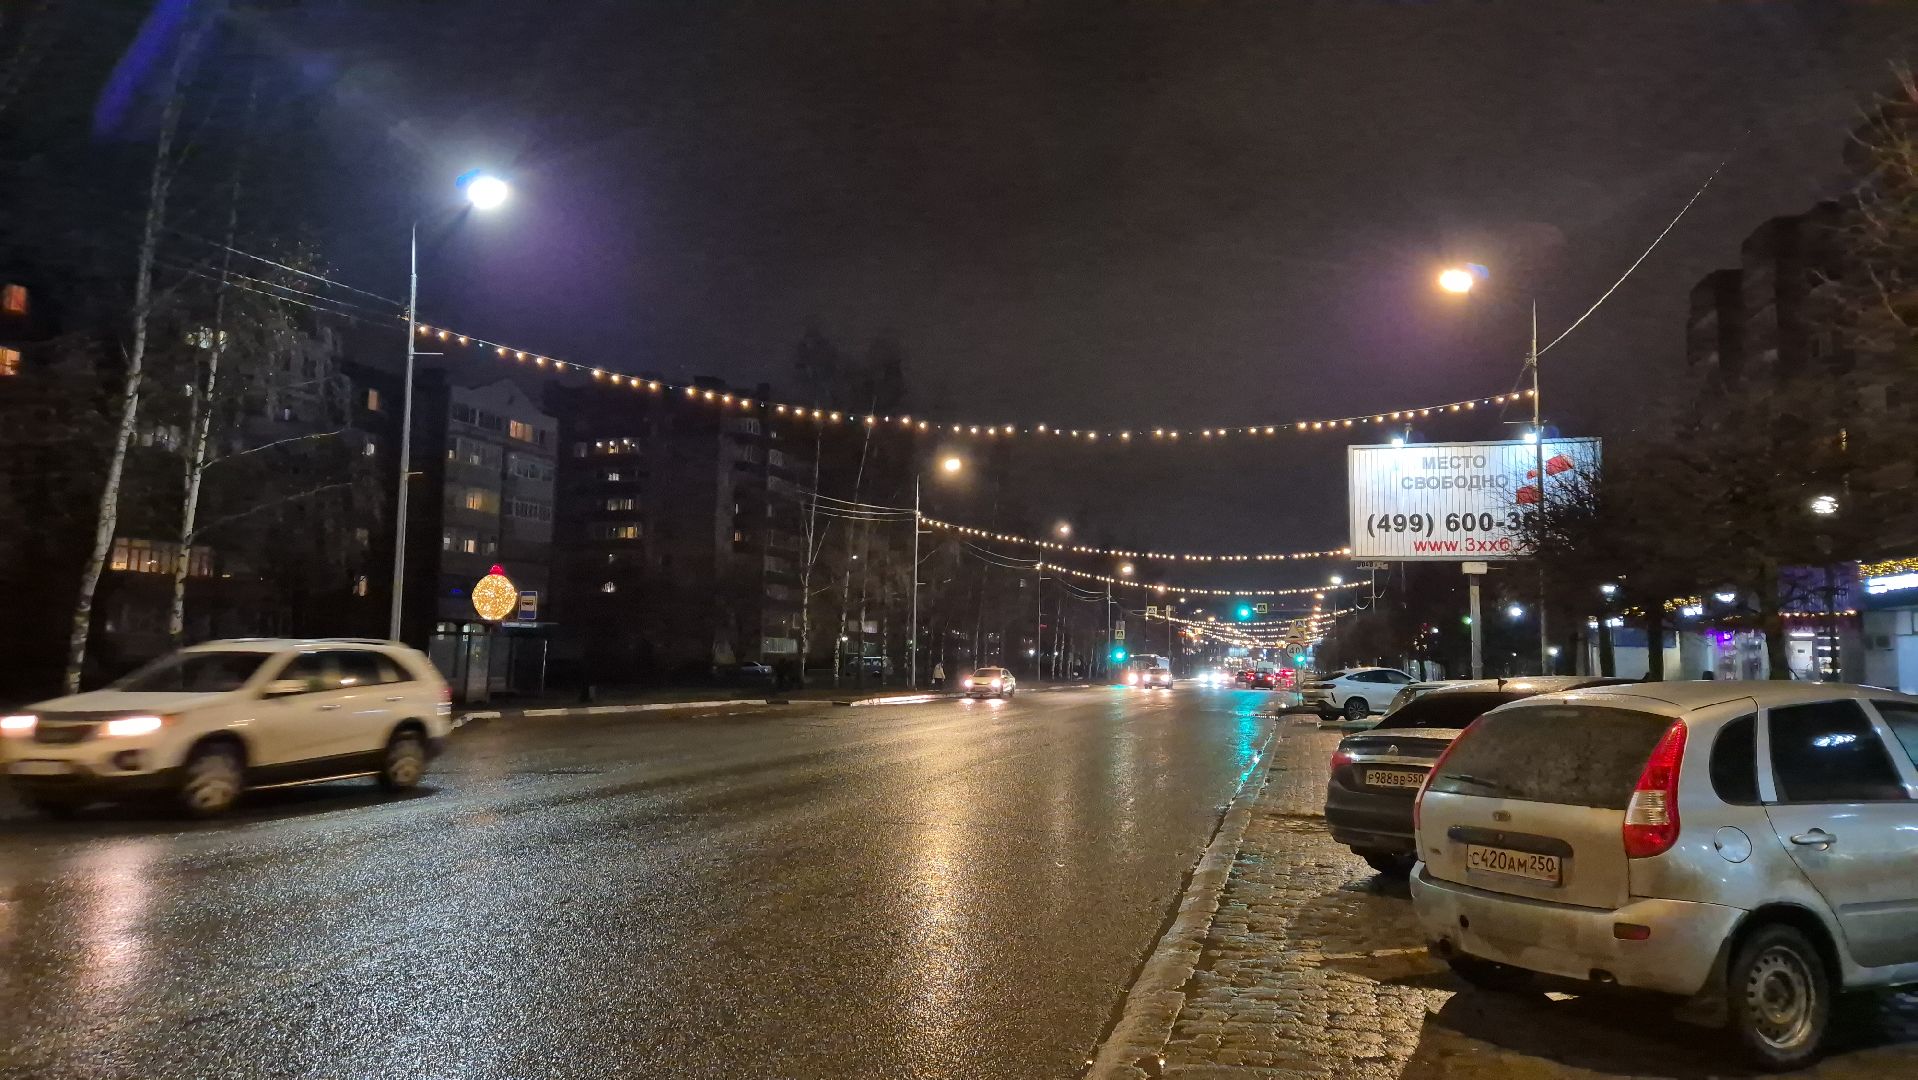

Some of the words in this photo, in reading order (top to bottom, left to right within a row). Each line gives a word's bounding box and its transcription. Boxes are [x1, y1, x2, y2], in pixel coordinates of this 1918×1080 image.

[1422, 455, 1487, 470] МЕСТО
[1401, 473, 1509, 491] СВОБОДНО
[1367, 512, 1434, 538] (499)
